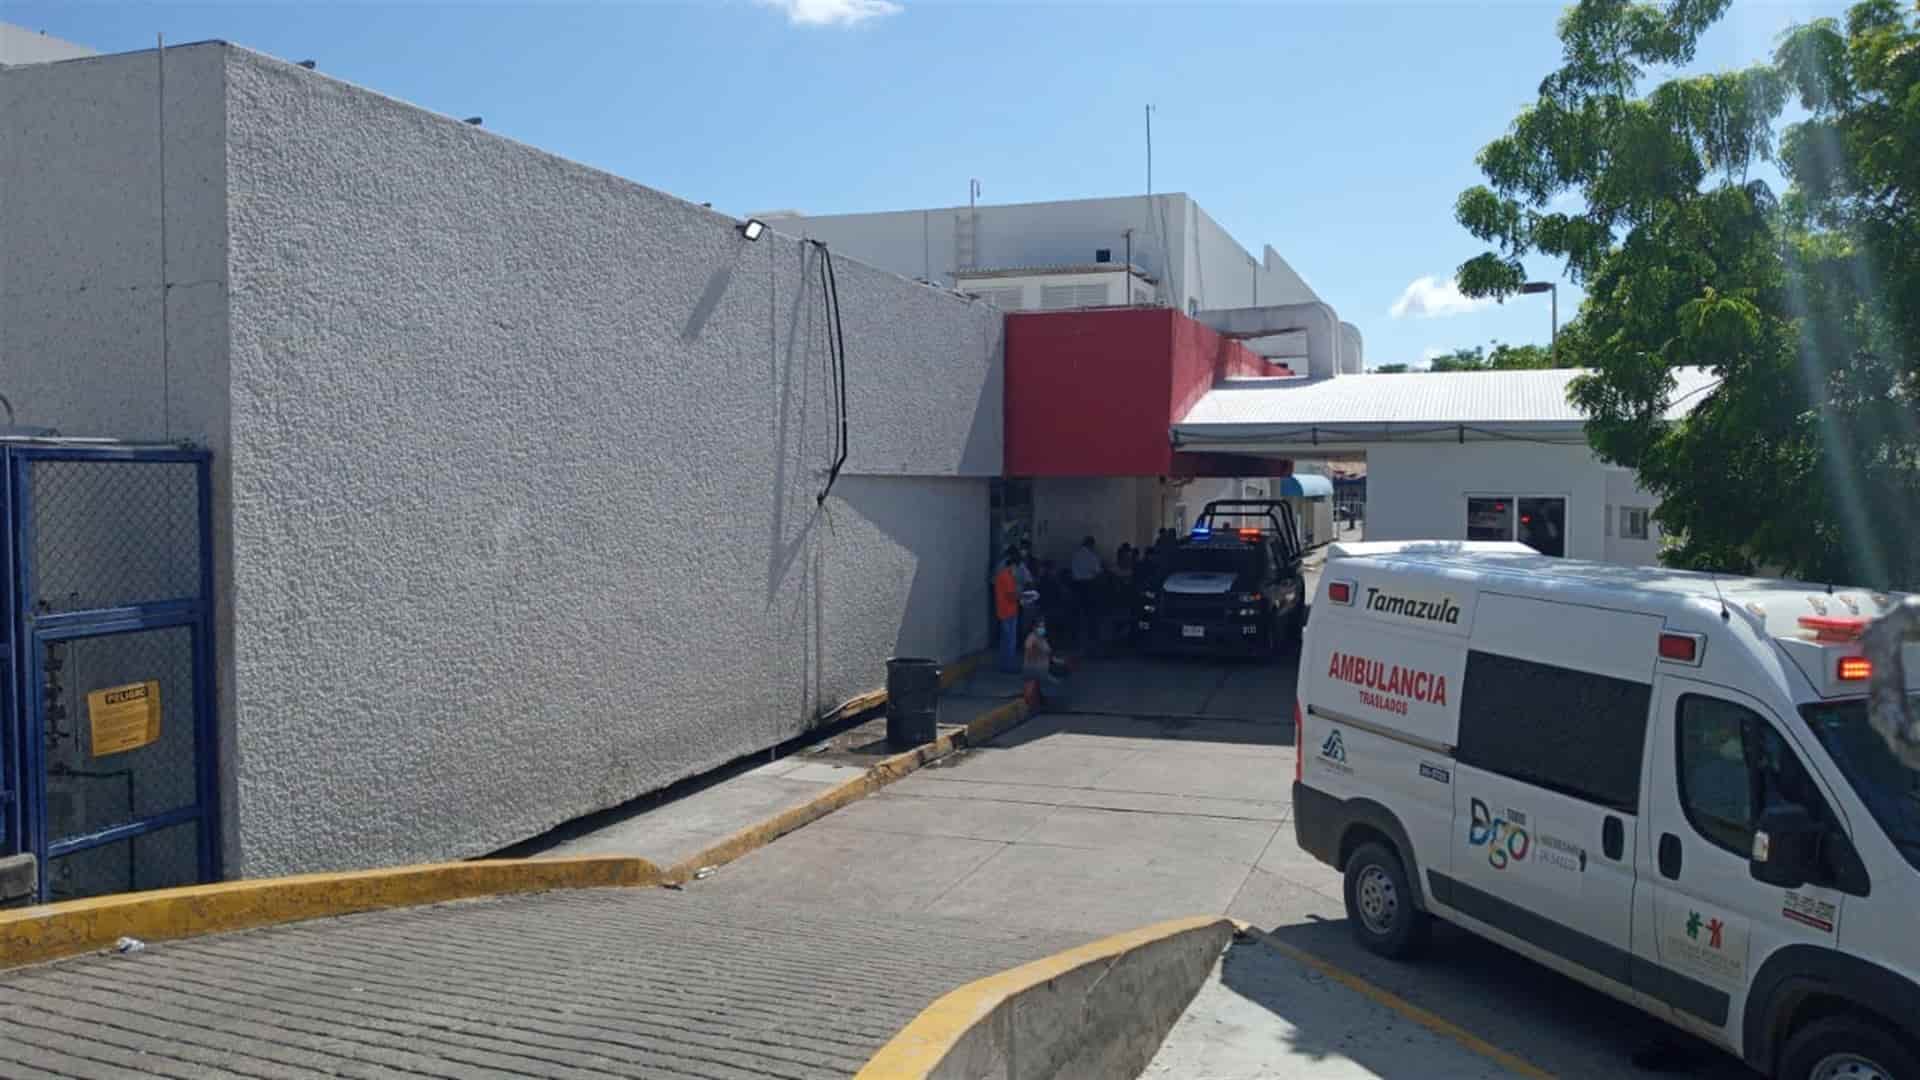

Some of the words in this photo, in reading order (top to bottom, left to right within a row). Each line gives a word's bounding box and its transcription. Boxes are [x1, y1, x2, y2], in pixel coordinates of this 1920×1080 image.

[1366, 587, 1460, 624] Tamazula
[1328, 651, 1447, 706] AMBULANCIA
[1360, 691, 1408, 716] TRASLADOS
